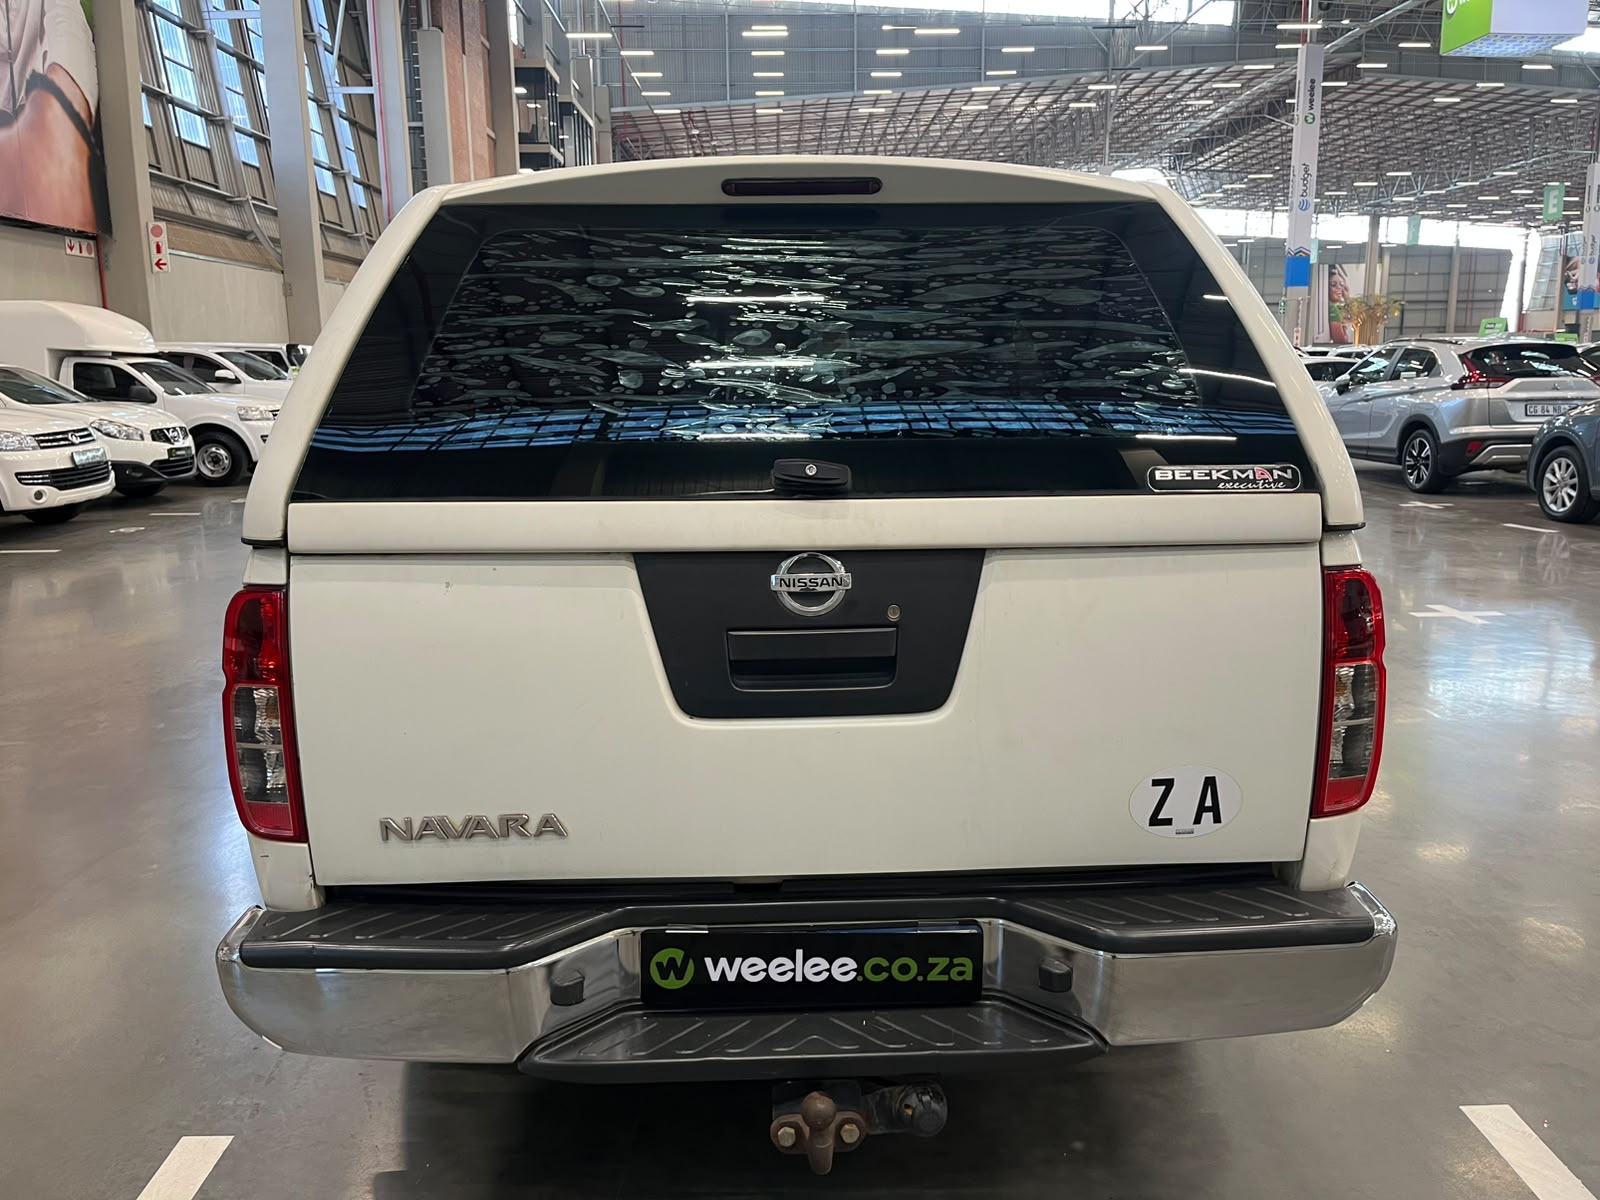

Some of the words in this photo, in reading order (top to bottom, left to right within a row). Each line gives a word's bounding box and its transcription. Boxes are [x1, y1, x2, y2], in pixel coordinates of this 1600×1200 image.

[1307, 78, 1316, 111] weelee
[1300, 162, 1312, 197] budget
[1548, 189, 1559, 214] E
[1528, 405, 1538, 414] CG
[1540, 405, 1550, 414] 84
[1154, 467, 1293, 481] BEEKMAN
[1217, 480, 1286, 489] executive
[779, 576, 843, 588] NISSAN
[379, 812, 568, 842] NAVARA
[704, 948, 974, 983] weelee.co.za
